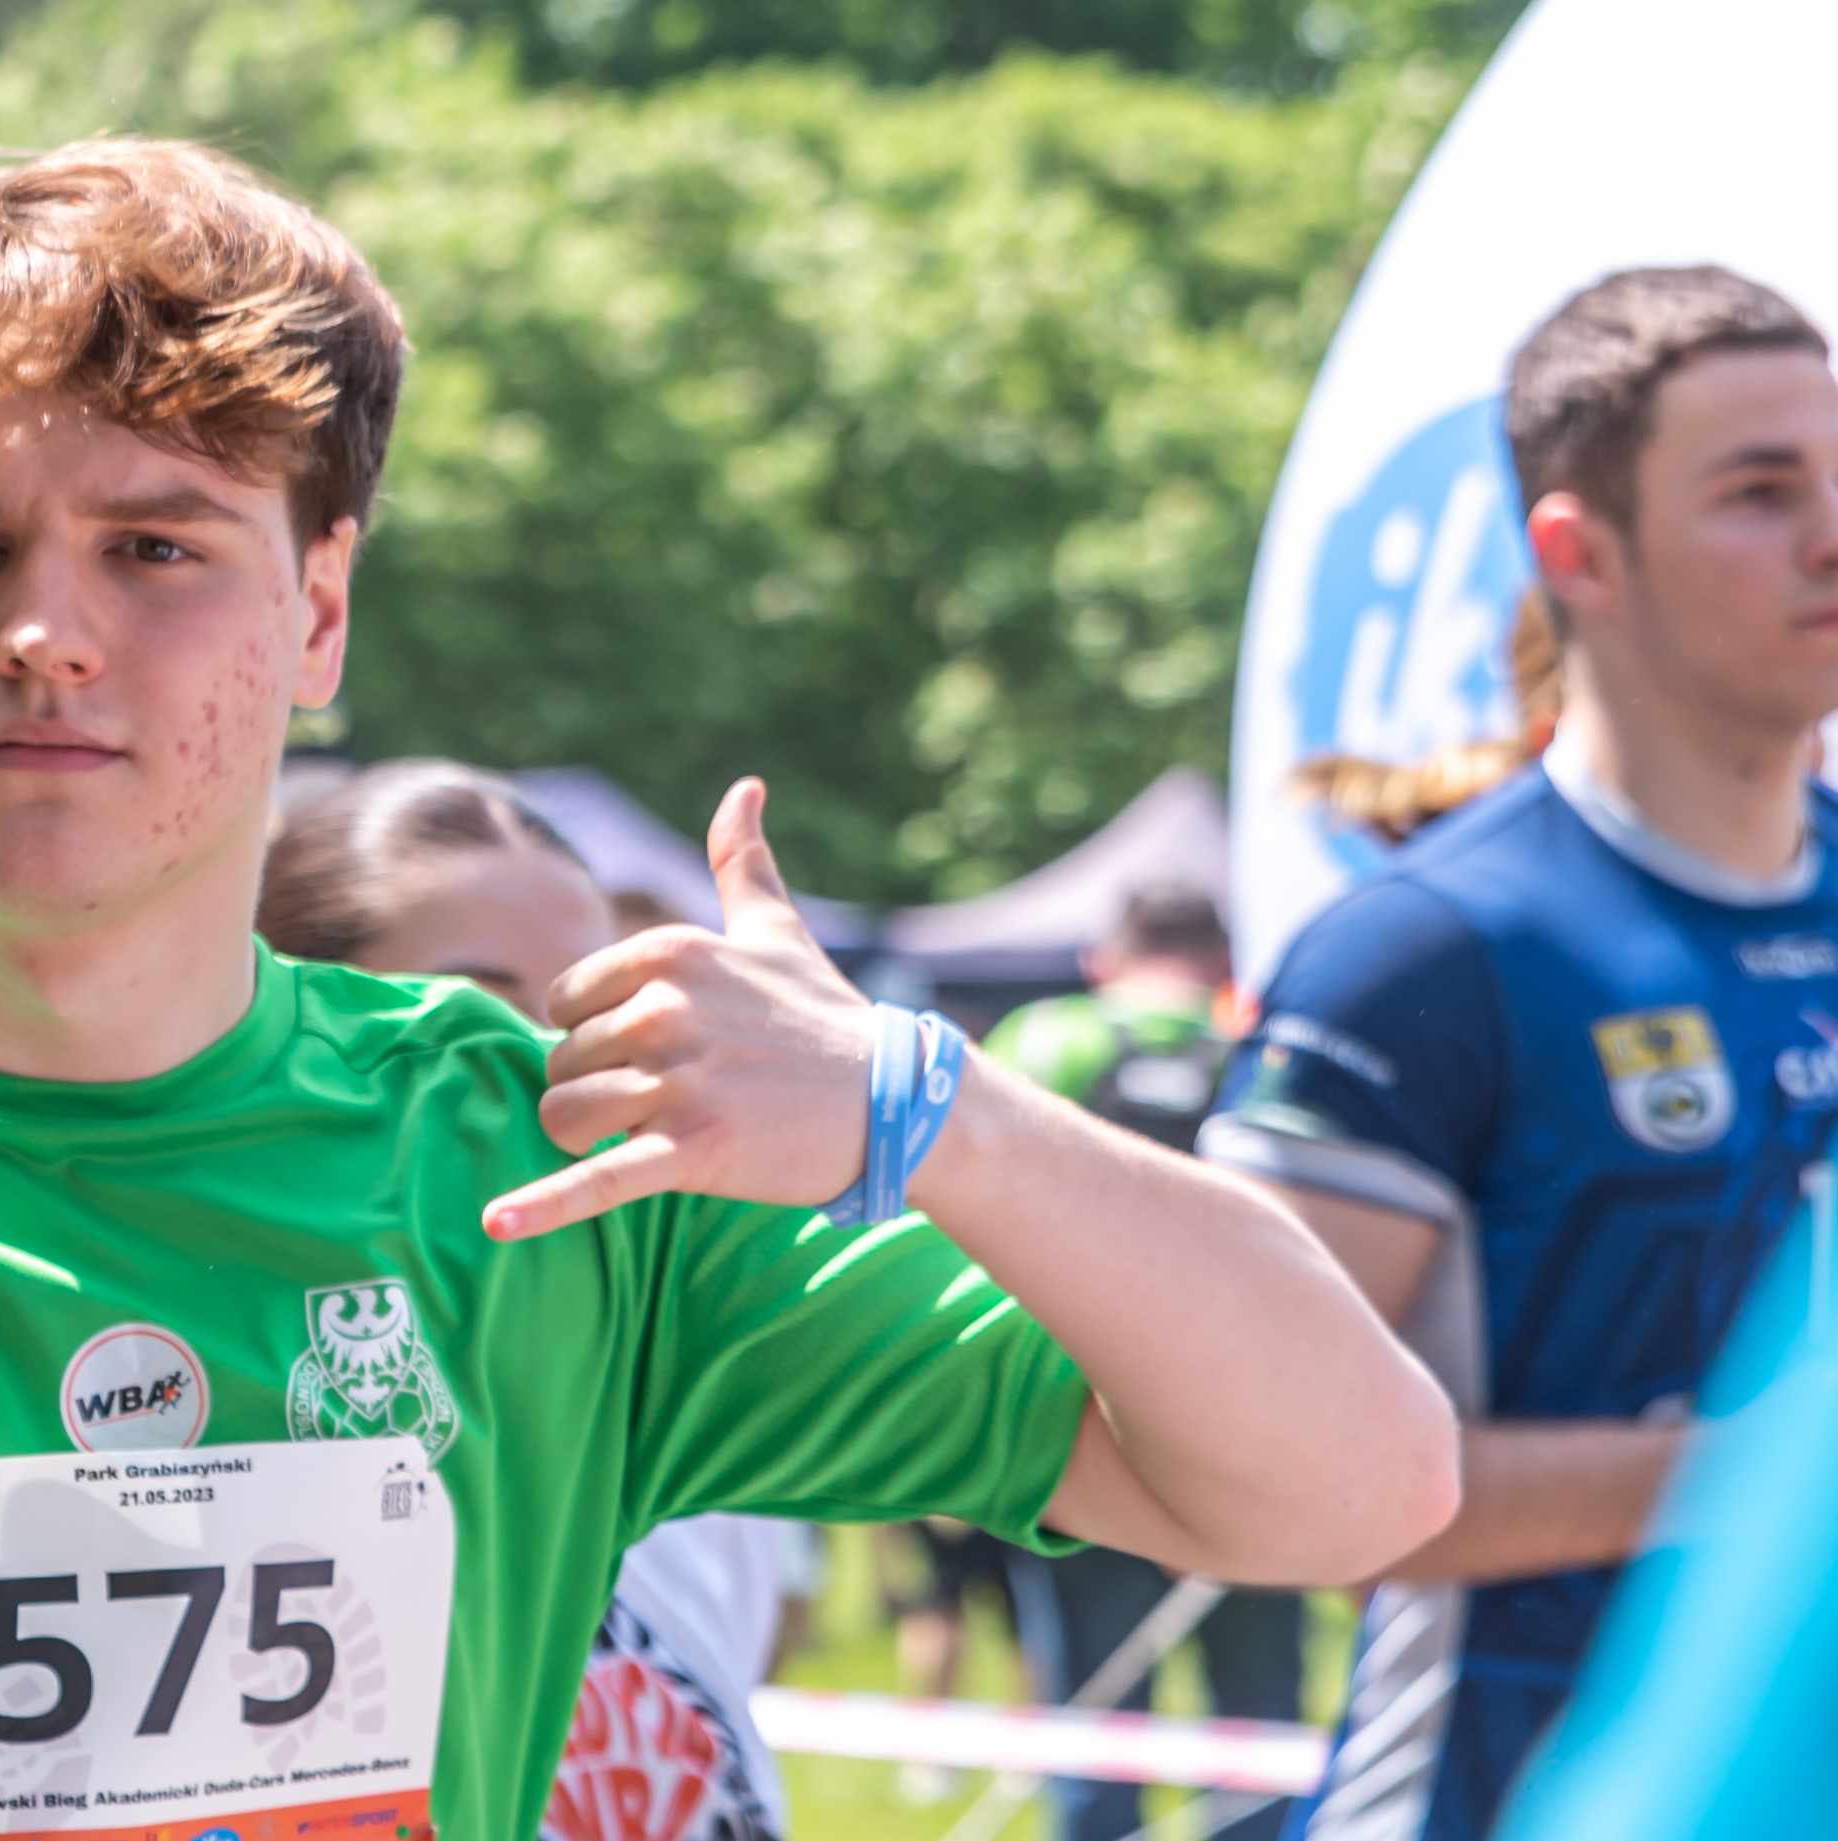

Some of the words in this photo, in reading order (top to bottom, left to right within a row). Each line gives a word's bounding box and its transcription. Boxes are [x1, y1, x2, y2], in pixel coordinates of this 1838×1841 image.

[74, 1467, 118, 1482] Park
[125, 1458, 252, 1479] Grabiszyński
[119, 1487, 215, 1507] 21.05.2023
[43, 1793, 88, 1811] Bieg
[94, 1783, 199, 1806] Akademicki
[203, 1773, 285, 1796] Duda-Cars
[289, 1757, 410, 1784] Mercedes-Benz
